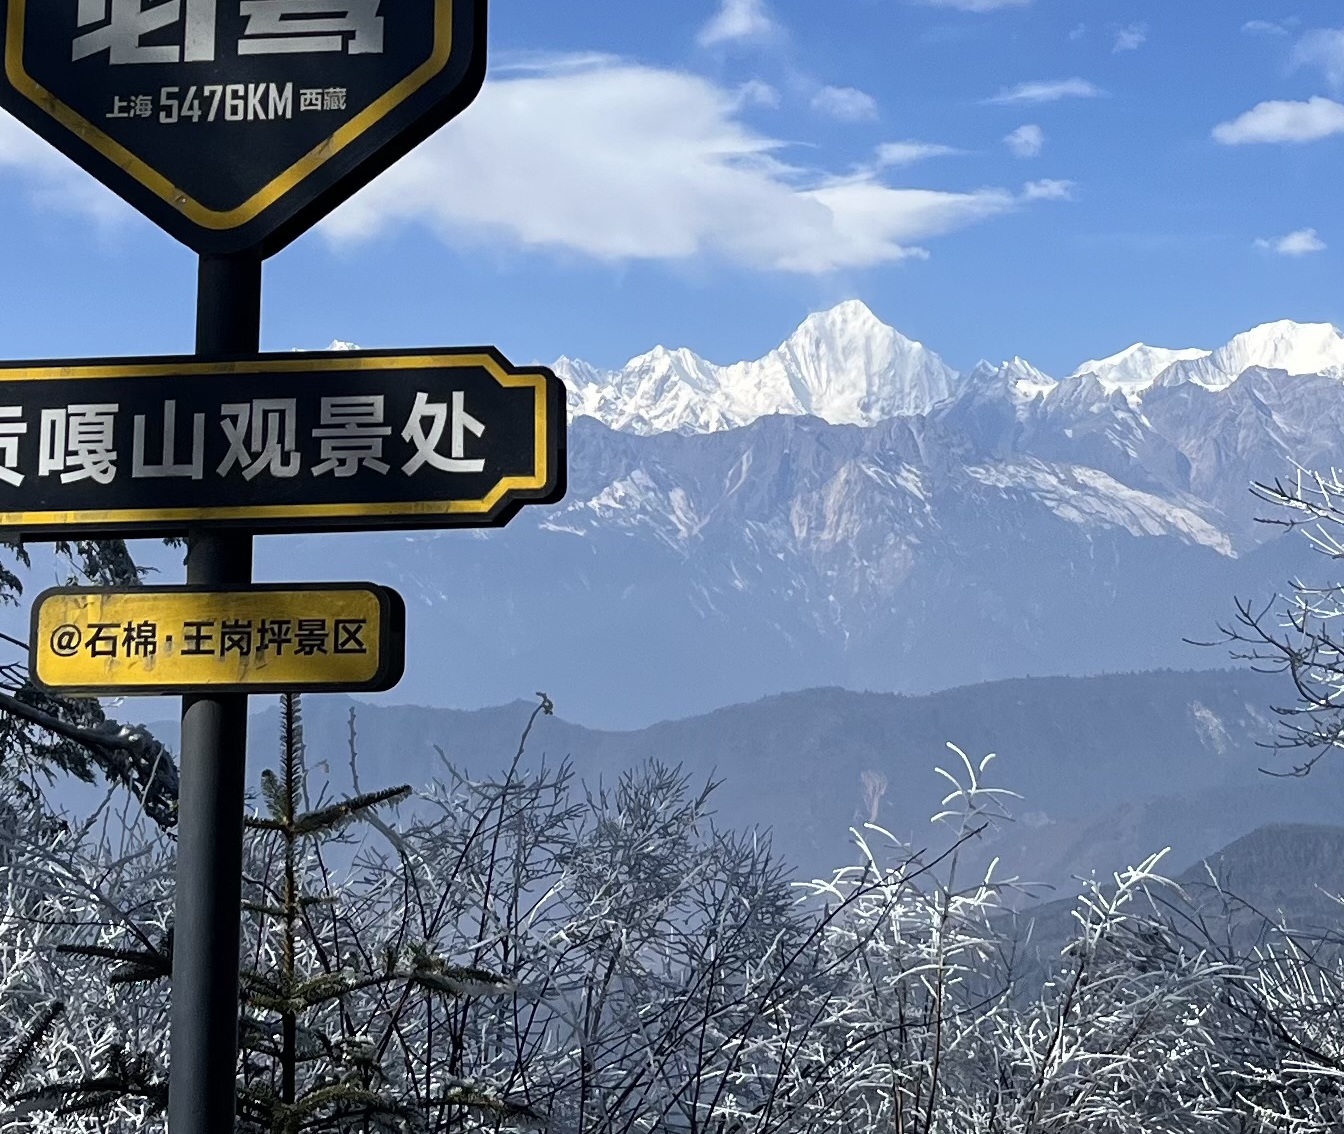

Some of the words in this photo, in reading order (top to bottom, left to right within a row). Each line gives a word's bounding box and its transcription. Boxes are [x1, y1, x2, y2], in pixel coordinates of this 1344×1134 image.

[105, 95, 153, 119] 上海
[158, 82, 293, 124] 5476KM
[299, 87, 347, 112] 西藏
[49, 618, 368, 659] @石棉·王岗坪景区
